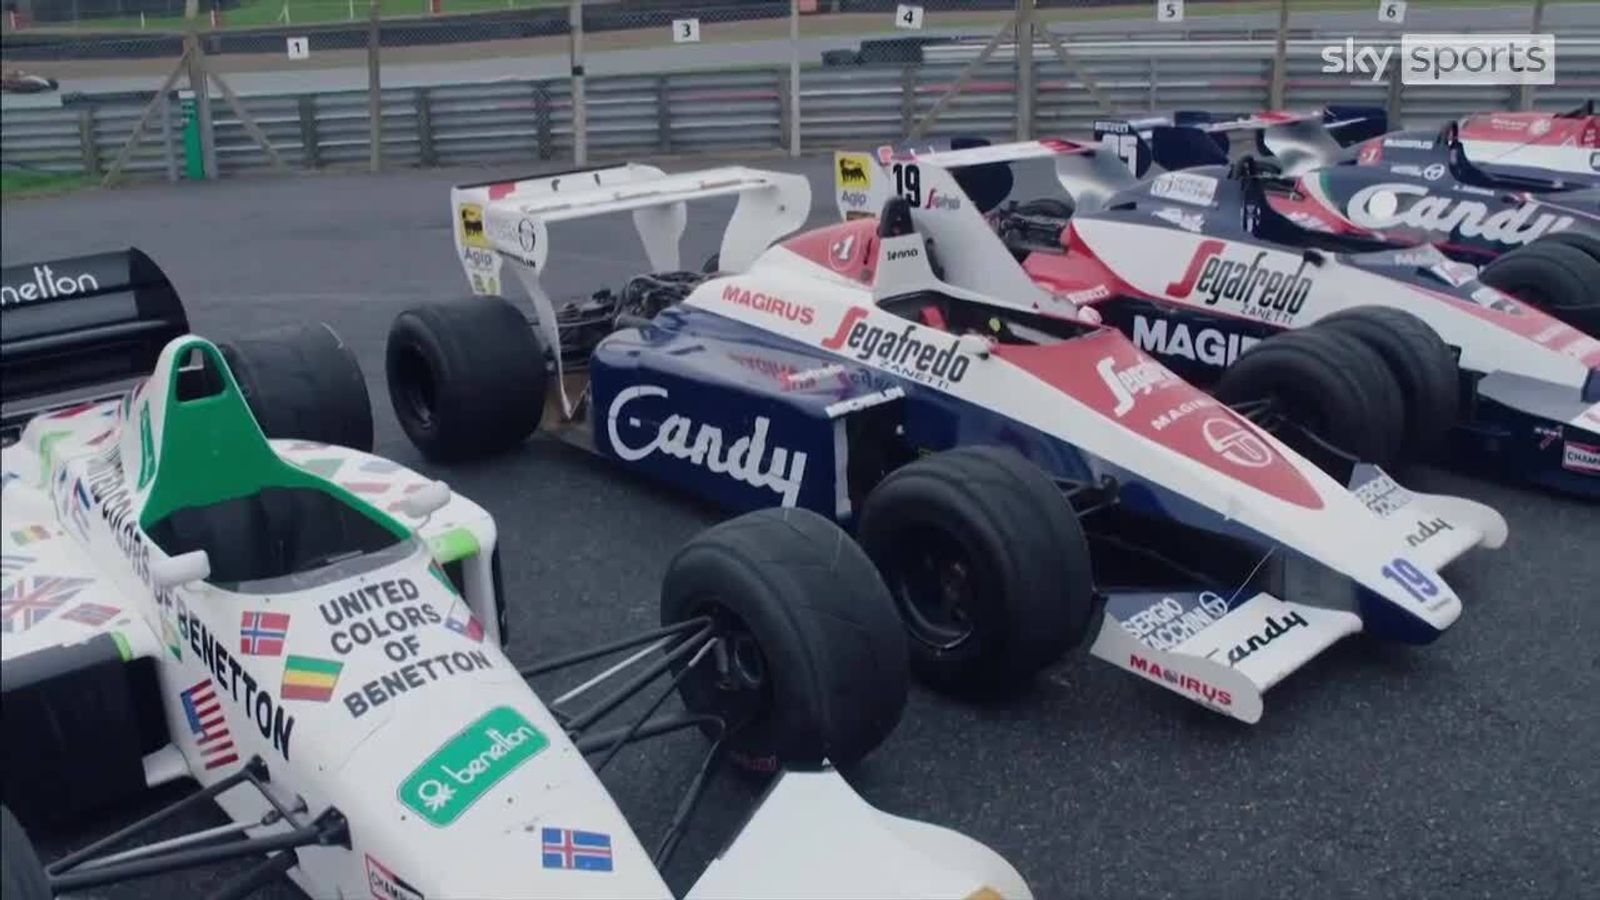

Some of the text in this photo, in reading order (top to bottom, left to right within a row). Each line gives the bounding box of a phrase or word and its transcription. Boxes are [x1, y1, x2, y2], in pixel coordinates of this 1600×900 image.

[681, 24, 691, 37] 3
[903, 11, 914, 24] 4
[1166, 4, 1176, 18] 5
[1386, 5, 1396, 18] 6
[892, 163, 921, 209] 19
[1346, 182, 1575, 245] Candy
[1164, 239, 1312, 316] Segafredo
[721, 284, 816, 325] MAGIRUS
[820, 304, 971, 384] Segafredo
[607, 384, 807, 509] Candy
[1407, 517, 1454, 548] ndy
[319, 578, 420, 626] UNITED
[1381, 557, 1440, 603] 19
[330, 603, 442, 655] COLORS
[384, 635, 420, 662] OF
[174, 592, 295, 762] BENETTON
[343, 650, 492, 718] BENETTON
[1130, 654, 1232, 706] MAGIRUS
[440, 725, 536, 785] benetton
